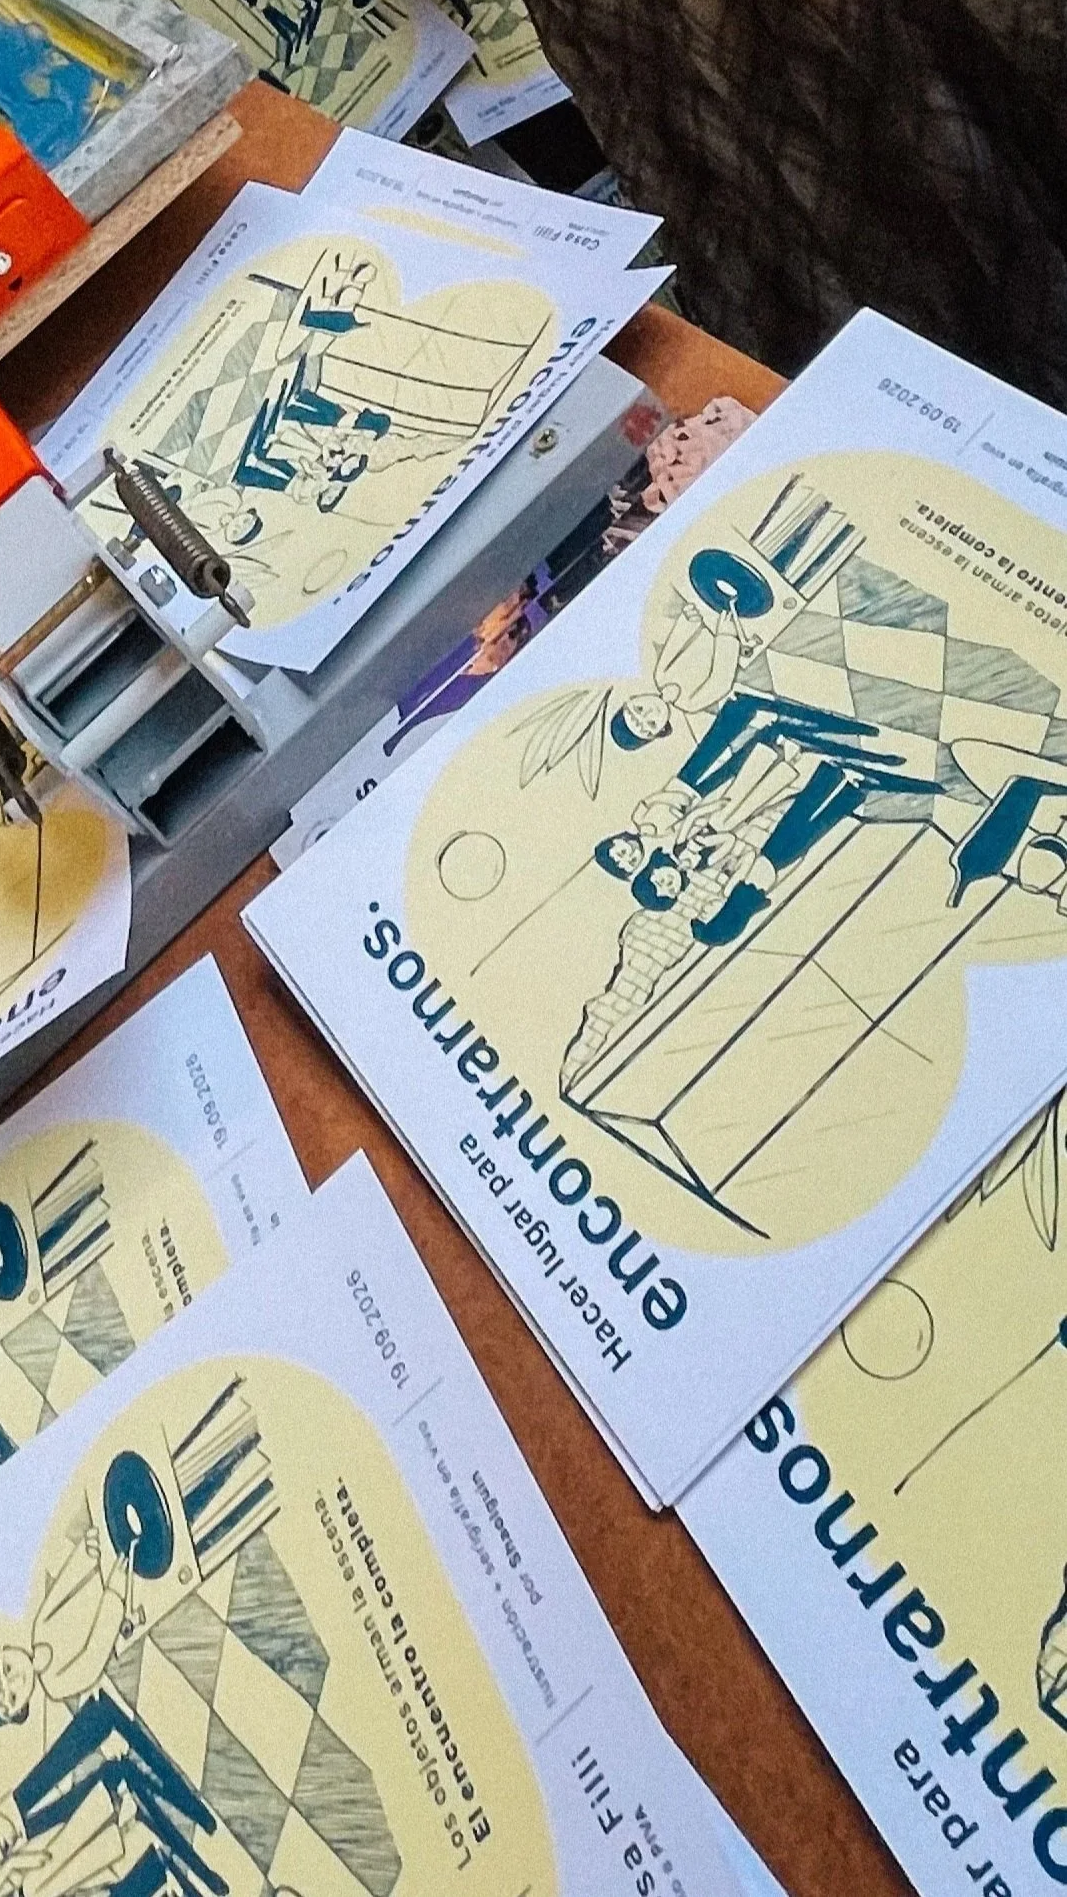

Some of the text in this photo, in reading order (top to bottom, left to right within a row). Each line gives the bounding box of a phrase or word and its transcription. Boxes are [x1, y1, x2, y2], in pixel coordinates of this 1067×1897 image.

[332, 316, 598, 606] encontrarnos.
[953, 553, 972, 572] la
[971, 564, 1024, 604] arman
[997, 555, 1016, 575] la
[1017, 568, 1067, 610] entro
[363, 900, 688, 1332] encontrarnos.
[459, 1133, 632, 1374] Hacer lugar para
[346, 1268, 410, 1391] 19.09.2026
[518, 1571, 543, 1607] por
[314, 1488, 472, 1873] Los objetos arman la escena.
[335, 1475, 492, 1844] El encuentro la completa.
[571, 1745, 624, 1836] Filli
[894, 1737, 980, 1851] para
